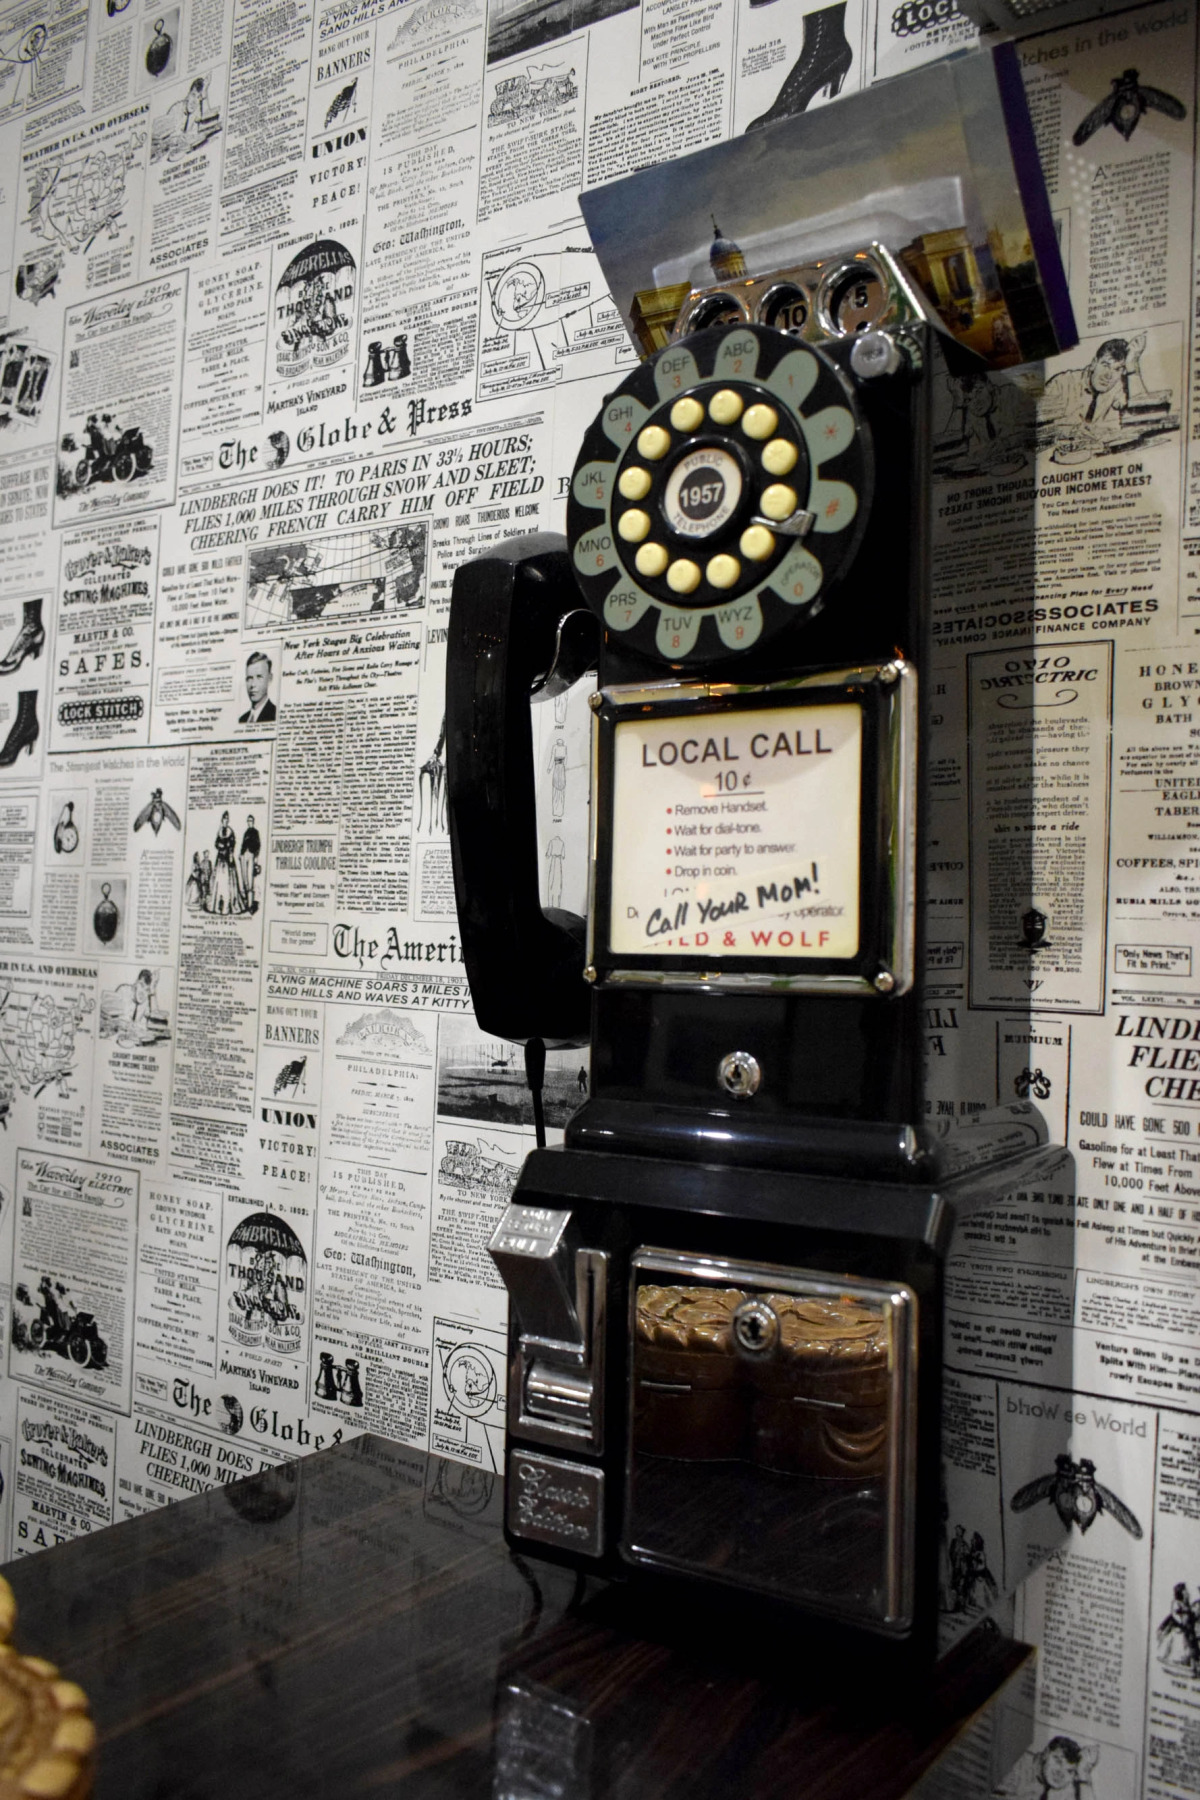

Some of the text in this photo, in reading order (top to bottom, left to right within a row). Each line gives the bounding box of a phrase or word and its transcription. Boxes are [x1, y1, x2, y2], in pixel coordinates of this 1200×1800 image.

[650, 28, 676, 42] Machine
[693, 19, 703, 30] Like
[703, 13, 715, 26] Bird
[652, 24, 712, 50] Under Perfect Control
[1020, 43, 1069, 67] tches
[1075, 37, 1092, 53] in
[1098, 28, 1129, 48] the
[317, 48, 371, 82] BANNERS
[311, 126, 367, 159] UNION
[310, 156, 367, 186] VICTORY!
[312, 184, 361, 209] PEACE!
[150, 238, 209, 266] ASSOCIATES
[855, 286, 868, 307] 5
[781, 305, 807, 330] 10
[722, 339, 755, 358] ABC
[662, 356, 690, 375] DEF
[733, 360, 742, 373] 2
[673, 376, 682, 389] 3
[788, 375, 793, 387] 1
[267, 383, 347, 414] MARTHA'S VINEYARD
[608, 406, 633, 422] GHI
[218, 397, 473, 471] The Globe & Press
[624, 423, 632, 432] 4
[684, 454, 723, 470] PUBLIC
[179, 488, 258, 517] LINDBERGH
[263, 479, 299, 501] DOES
[304, 473, 326, 493] IT!
[335, 468, 356, 487] TO
[359, 456, 408, 482] PARIS
[411, 453, 432, 472] IN
[468, 433, 533, 462] HOURS;
[581, 472, 606, 487] JKL
[1042, 463, 1143, 486] CAUGHT SHORT ON
[1066, 480, 1108, 495] INCOME
[1112, 475, 1152, 490] TAXES?
[184, 455, 537, 535] FLIES 1,000 MILES THROUGH SNOW AND SLEET;
[596, 487, 604, 499] 5
[680, 482, 723, 508] 1957
[190, 525, 259, 551] CHEERING
[267, 512, 329, 539] FRENCH
[337, 502, 391, 526] CARRY
[399, 493, 436, 515] HIM
[445, 486, 479, 508] OFF
[489, 475, 545, 501] FIELD
[477, 508, 510, 524] THUNDEROUS
[515, 503, 540, 515] WELCOME
[673, 505, 731, 535] TELEPHONE
[578, 536, 611, 554] MNO
[596, 555, 604, 567] 6
[781, 561, 821, 585] OPERATOR
[609, 592, 637, 607] PRS
[794, 584, 803, 596] 0
[624, 611, 632, 622] 7
[718, 606, 753, 624] WYZ
[1035, 598, 1159, 622] SSOCIATES
[663, 616, 692, 632] TUV
[735, 627, 744, 639] 9
[1035, 617, 1151, 634] FINANCE COMPANY
[284, 630, 411, 650] New York Stages Big Celebration
[294, 650, 315, 661] After
[317, 649, 341, 659] Hours
[352, 643, 385, 656] Anxious
[389, 640, 420, 652] Waiting
[672, 635, 680, 648] 8
[59, 651, 150, 676] SAFES.
[63, 700, 138, 720] LOCK STITCH
[642, 729, 832, 768] LOCAL CALL
[675, 801, 769, 816] Remove Handset.
[675, 823, 762, 836] Wait for dial-tone.
[674, 843, 797, 858] Wait for party to answer.
[675, 866, 738, 879] Drop in coin.
[646, 902, 688, 938] Call
[333, 923, 379, 970] The
[723, 931, 736, 947] &
[751, 931, 830, 947] WOLF
[266, 974, 460, 996] FLYING MACHINE SOARS 3 MILES
[267, 985, 470, 1010] SAND HILLS AND WAVES AT KITTY
[265, 1023, 320, 1046] BANNERS
[261, 1107, 317, 1130] UNION
[1080, 1110, 1190, 1135] COULD HAVE GONE 500
[100, 1140, 160, 1158] ASSOCIATES
[259, 1138, 317, 1158] VICTORY!
[1079, 1139, 1176, 1160] Gasoline for at Least
[262, 1164, 311, 1183] PEACE!
[220, 1360, 299, 1390] MARTHA'S VINEYARD
[173, 1377, 326, 1451] The Globe
[1092, 1410, 1147, 1438] World
[135, 1418, 253, 1472] LINDBERGH DOES
